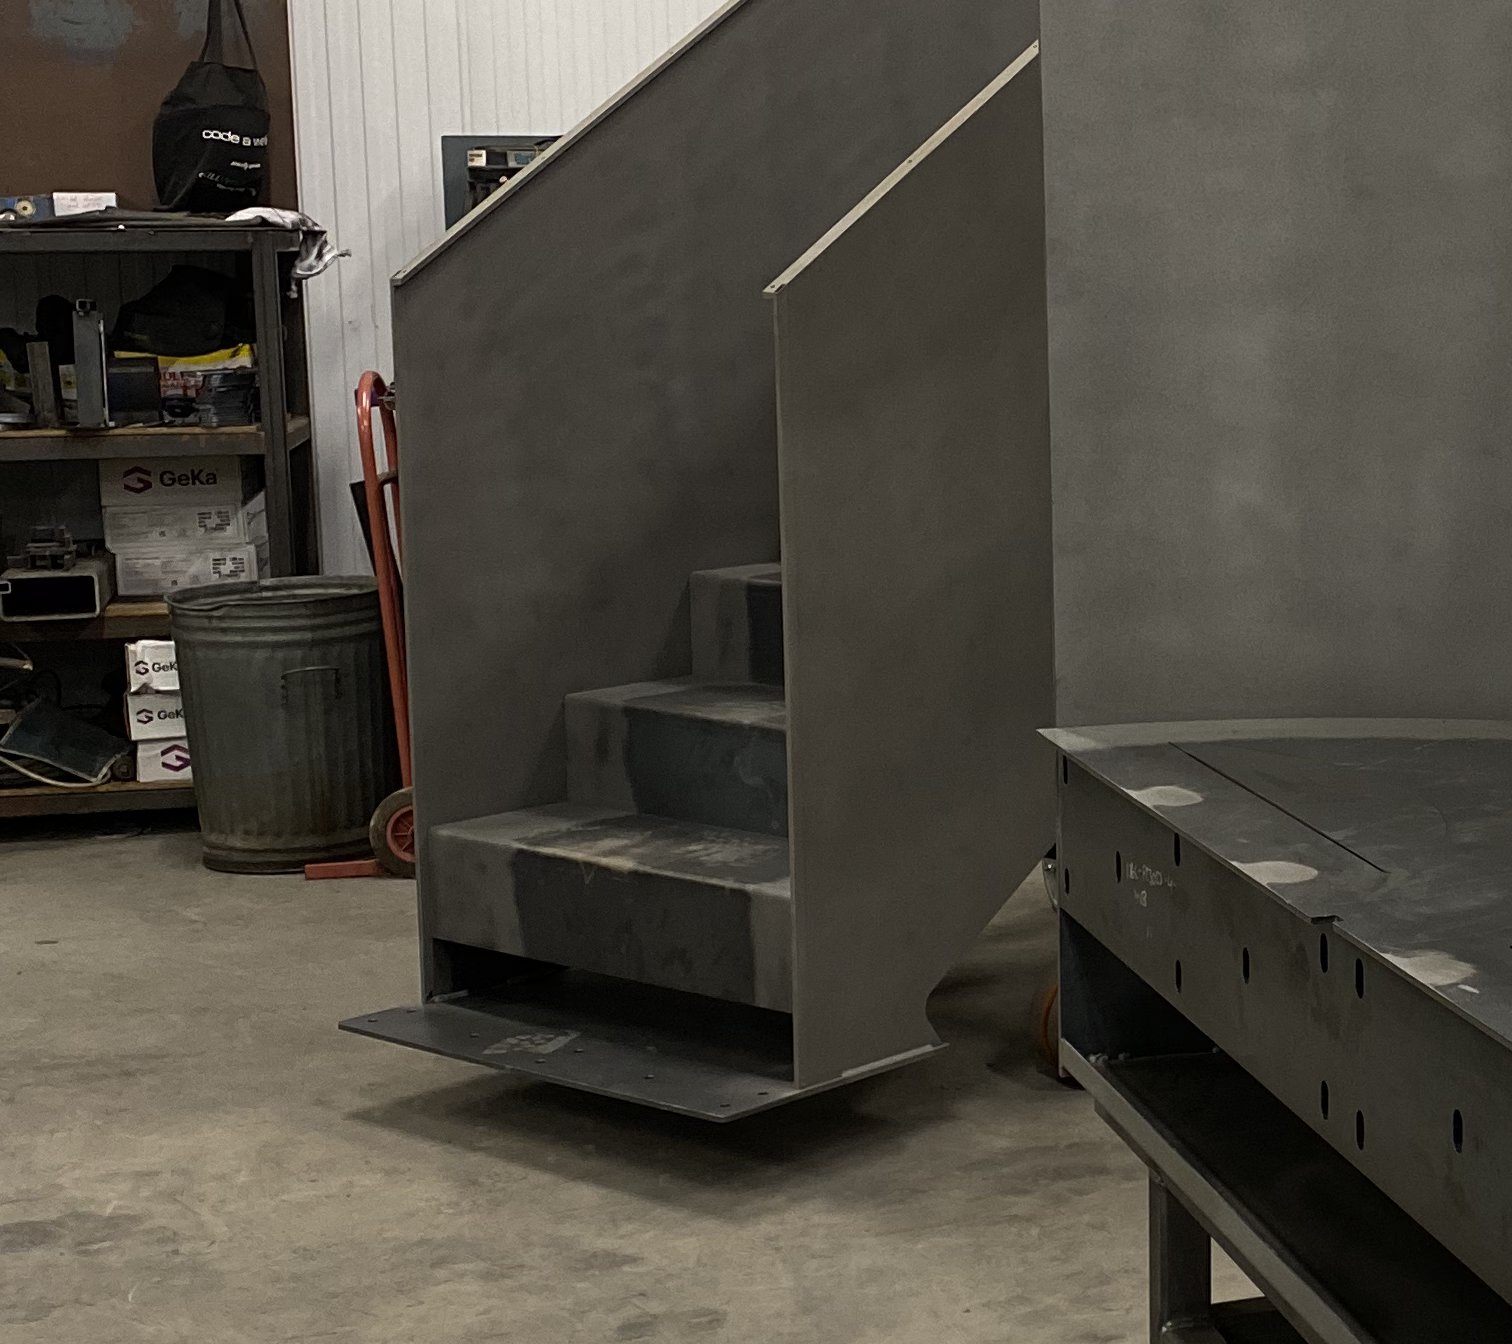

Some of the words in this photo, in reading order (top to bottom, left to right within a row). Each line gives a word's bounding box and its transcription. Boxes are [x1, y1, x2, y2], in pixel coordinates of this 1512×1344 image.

[202, 130, 240, 144] code
[242, 137, 251, 146] a
[159, 469, 217, 487] GeKa
[152, 661, 178, 673] GeK
[157, 709, 184, 720] GeK
